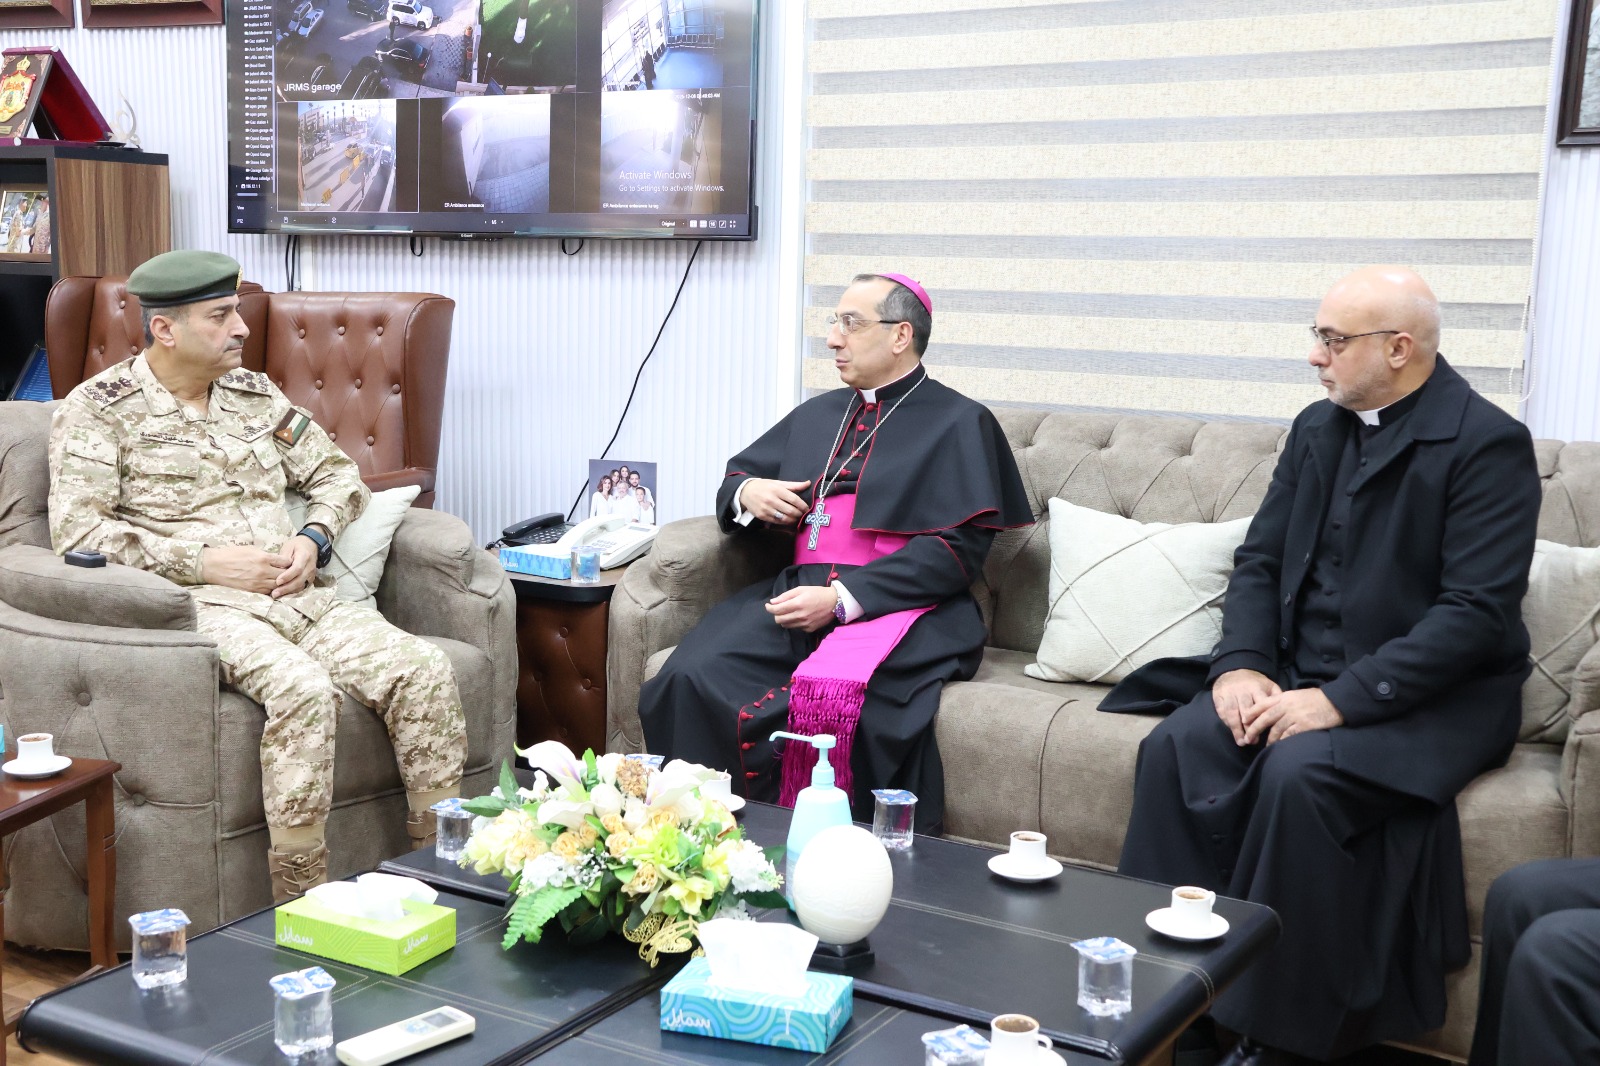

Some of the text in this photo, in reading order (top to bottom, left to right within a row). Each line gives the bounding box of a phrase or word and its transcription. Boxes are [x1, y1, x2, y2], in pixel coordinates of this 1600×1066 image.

[284, 83, 341, 93] JRMS garage
[619, 170, 691, 179] Activate Windows
[637, 184, 660, 193] Settings
[664, 1008, 711, 1028] سمايل
